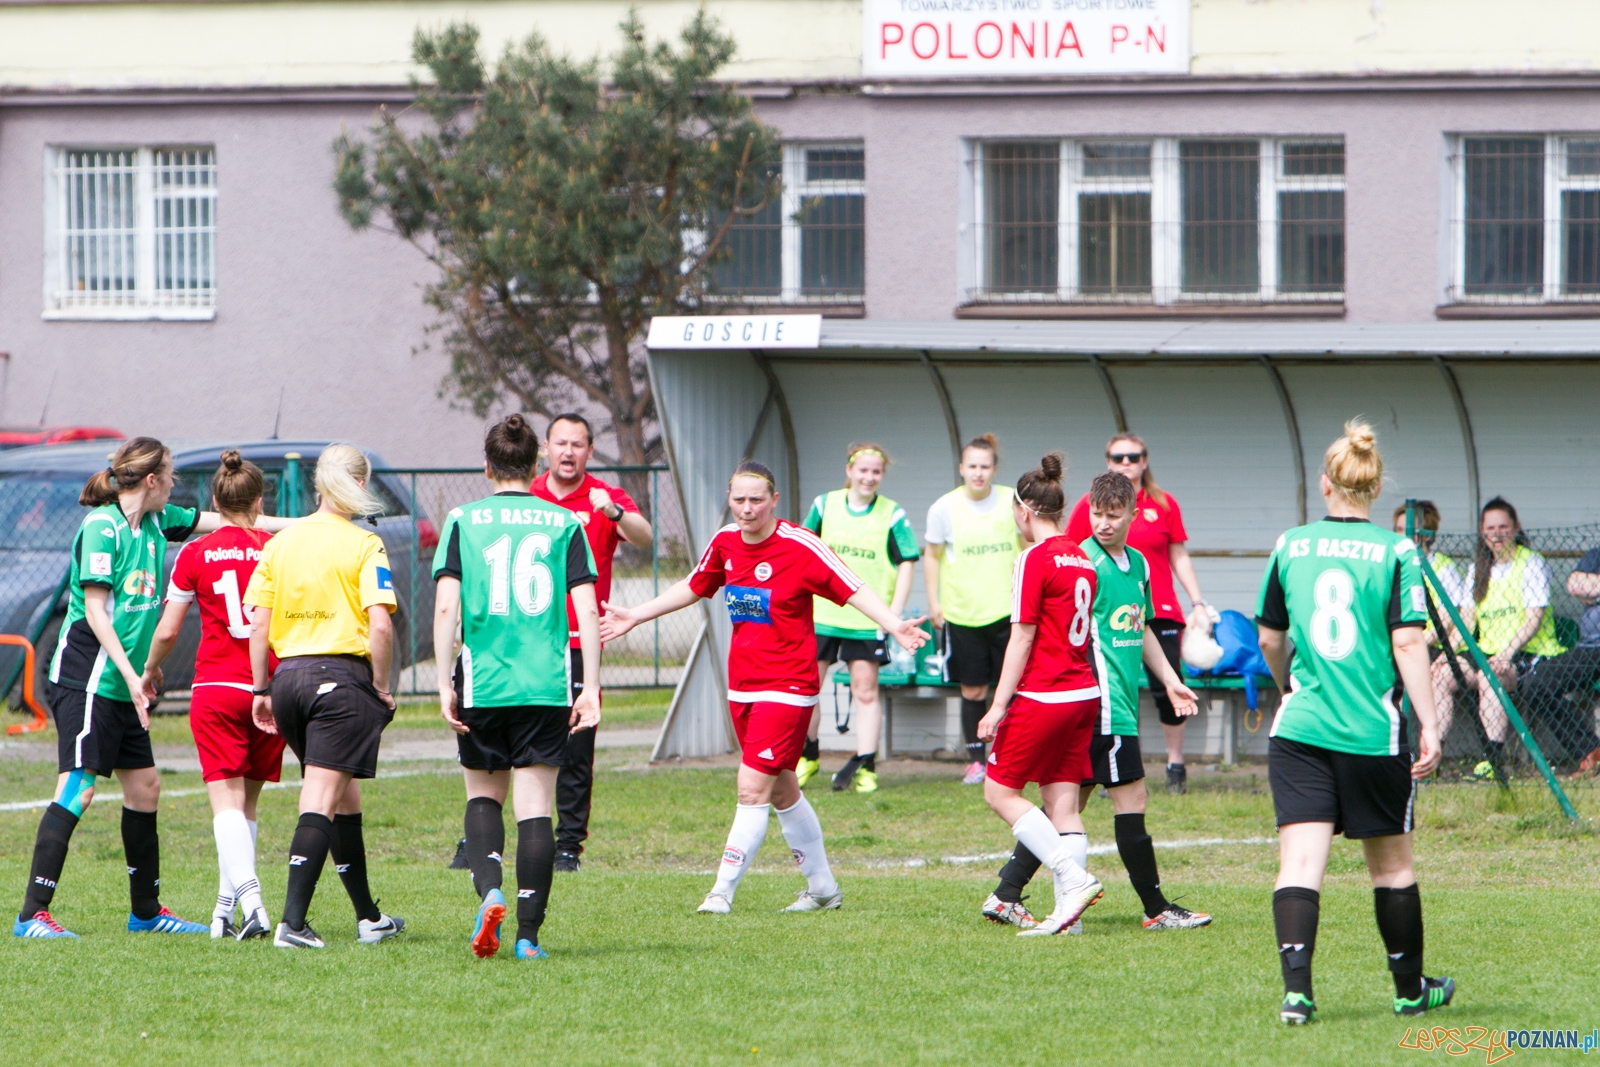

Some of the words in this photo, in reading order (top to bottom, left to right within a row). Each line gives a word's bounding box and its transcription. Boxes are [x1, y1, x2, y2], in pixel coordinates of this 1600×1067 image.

[880, 21, 1084, 60] POLONIA
[683, 321, 784, 342] GOŚCIE
[471, 508, 494, 525] KS
[500, 508, 565, 528] RASZYN
[204, 546, 244, 564] Polonia
[1289, 538, 1311, 558] KS
[1316, 538, 1387, 563] RASZYN
[482, 532, 554, 617] 16
[212, 569, 255, 639] 1
[1068, 577, 1092, 647] 8
[1310, 568, 1358, 661] 8
